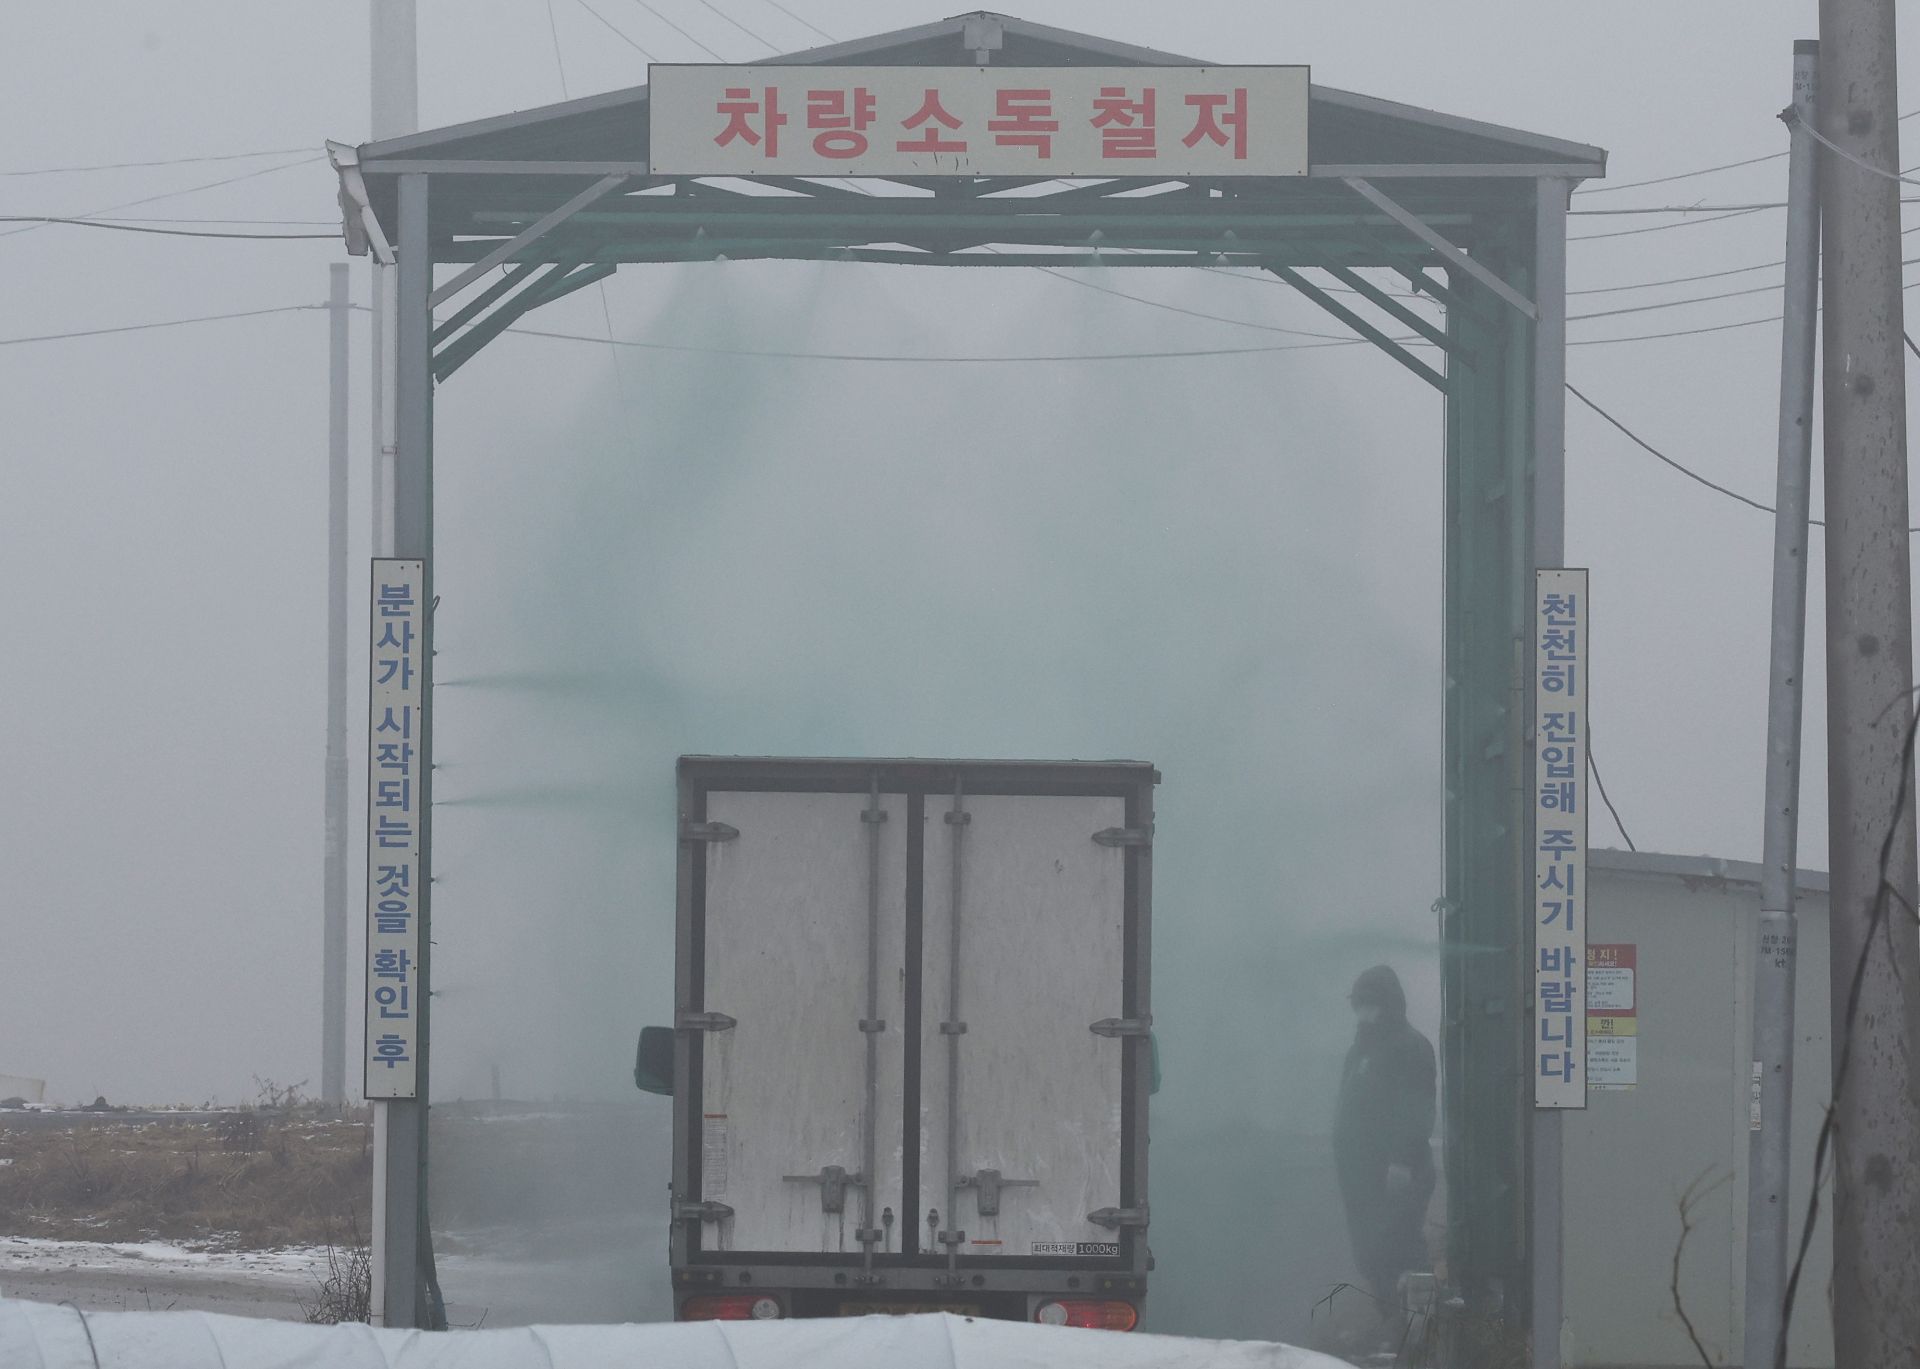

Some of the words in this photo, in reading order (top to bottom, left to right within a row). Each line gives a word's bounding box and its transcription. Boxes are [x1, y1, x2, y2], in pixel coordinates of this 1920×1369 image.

[714, 86, 1248, 160] 차량소독철저
[376, 584, 415, 690] 분사가
[1541, 593, 1577, 697] 천천히
[376, 705, 413, 848] 시작되는
[1540, 711, 1576, 815] 진입해
[374, 864, 411, 934] 것을
[1540, 830, 1576, 931] 주시기
[373, 949, 411, 1019] 확인
[1540, 946, 1576, 1083] 바랍니다
[373, 1034, 410, 1069] 후
[1079, 1244, 1119, 1255] 1000kg
